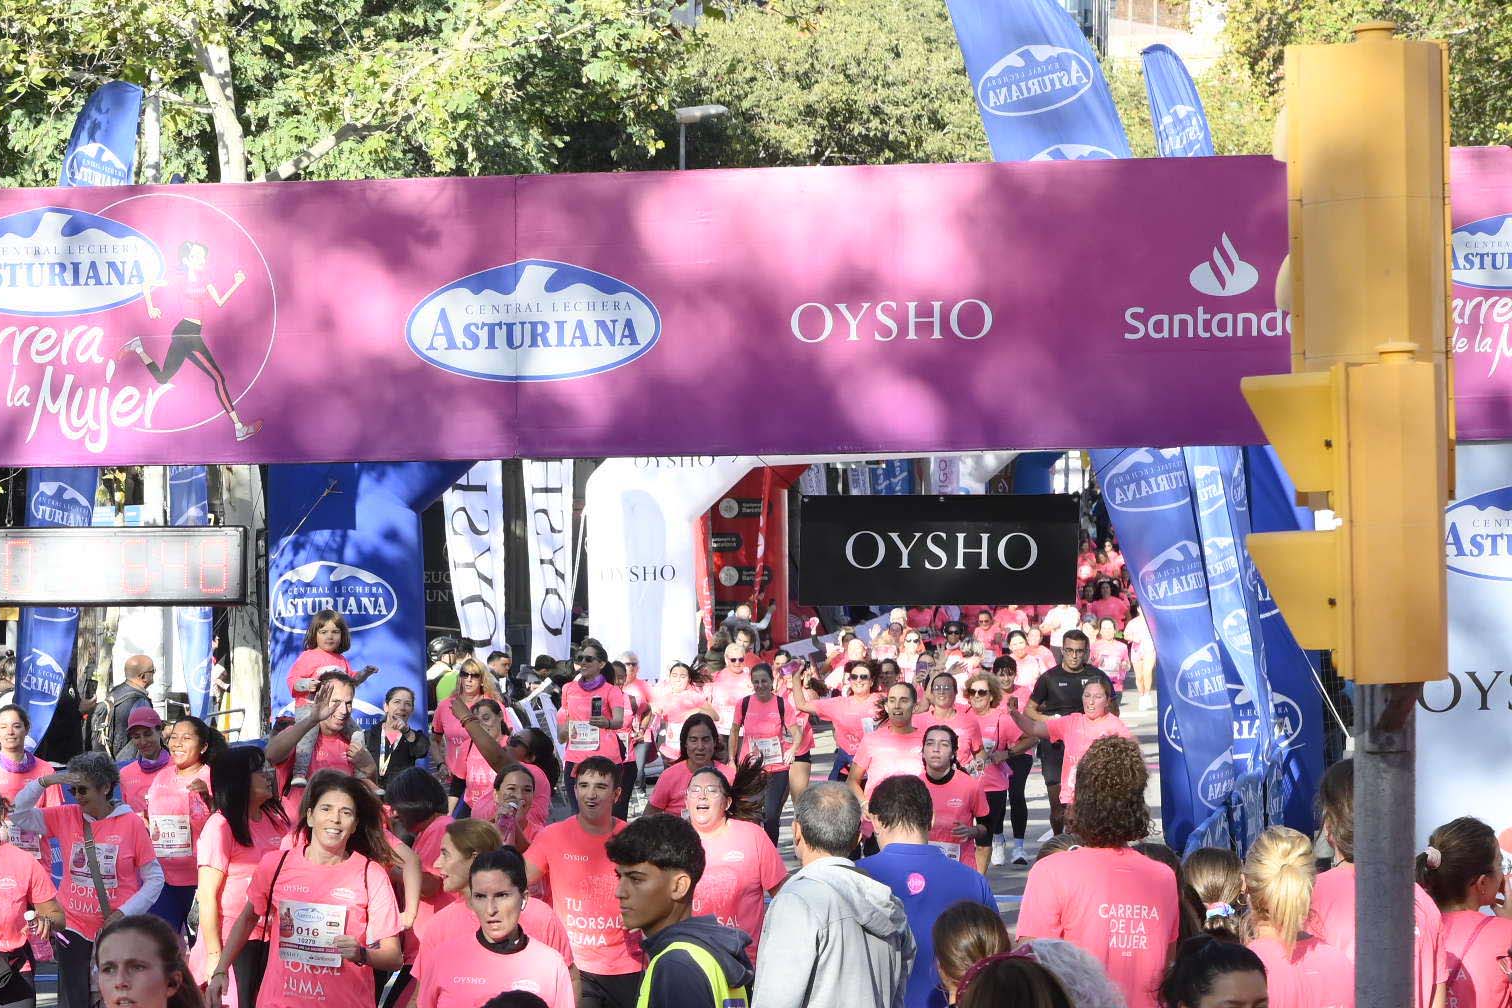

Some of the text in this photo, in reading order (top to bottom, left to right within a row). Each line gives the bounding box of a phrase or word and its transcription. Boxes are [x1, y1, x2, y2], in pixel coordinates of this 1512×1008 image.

[465, 299, 632, 316] CENTRAL LECHERA
[425, 307, 642, 350] ASTURIANA
[790, 299, 994, 343] OYSHO
[1124, 306, 1292, 341] Santand
[7, 369, 32, 408] la
[25, 360, 176, 454] Mujer
[1473, 518, 1512, 528] CENT
[845, 531, 1038, 572] OYSHO
[287, 585, 384, 595] CENTRAL LECHERA
[274, 591, 389, 618] ASTURIANA
[565, 897, 582, 912] TU
[1098, 903, 1159, 921] CARRERA
[567, 914, 622, 930] DORSAL
[1109, 919, 1146, 935] DE LA
[296, 926, 320, 937] 016
[1108, 934, 1149, 950] MUJER
[453, 976, 488, 985] OYSHO
